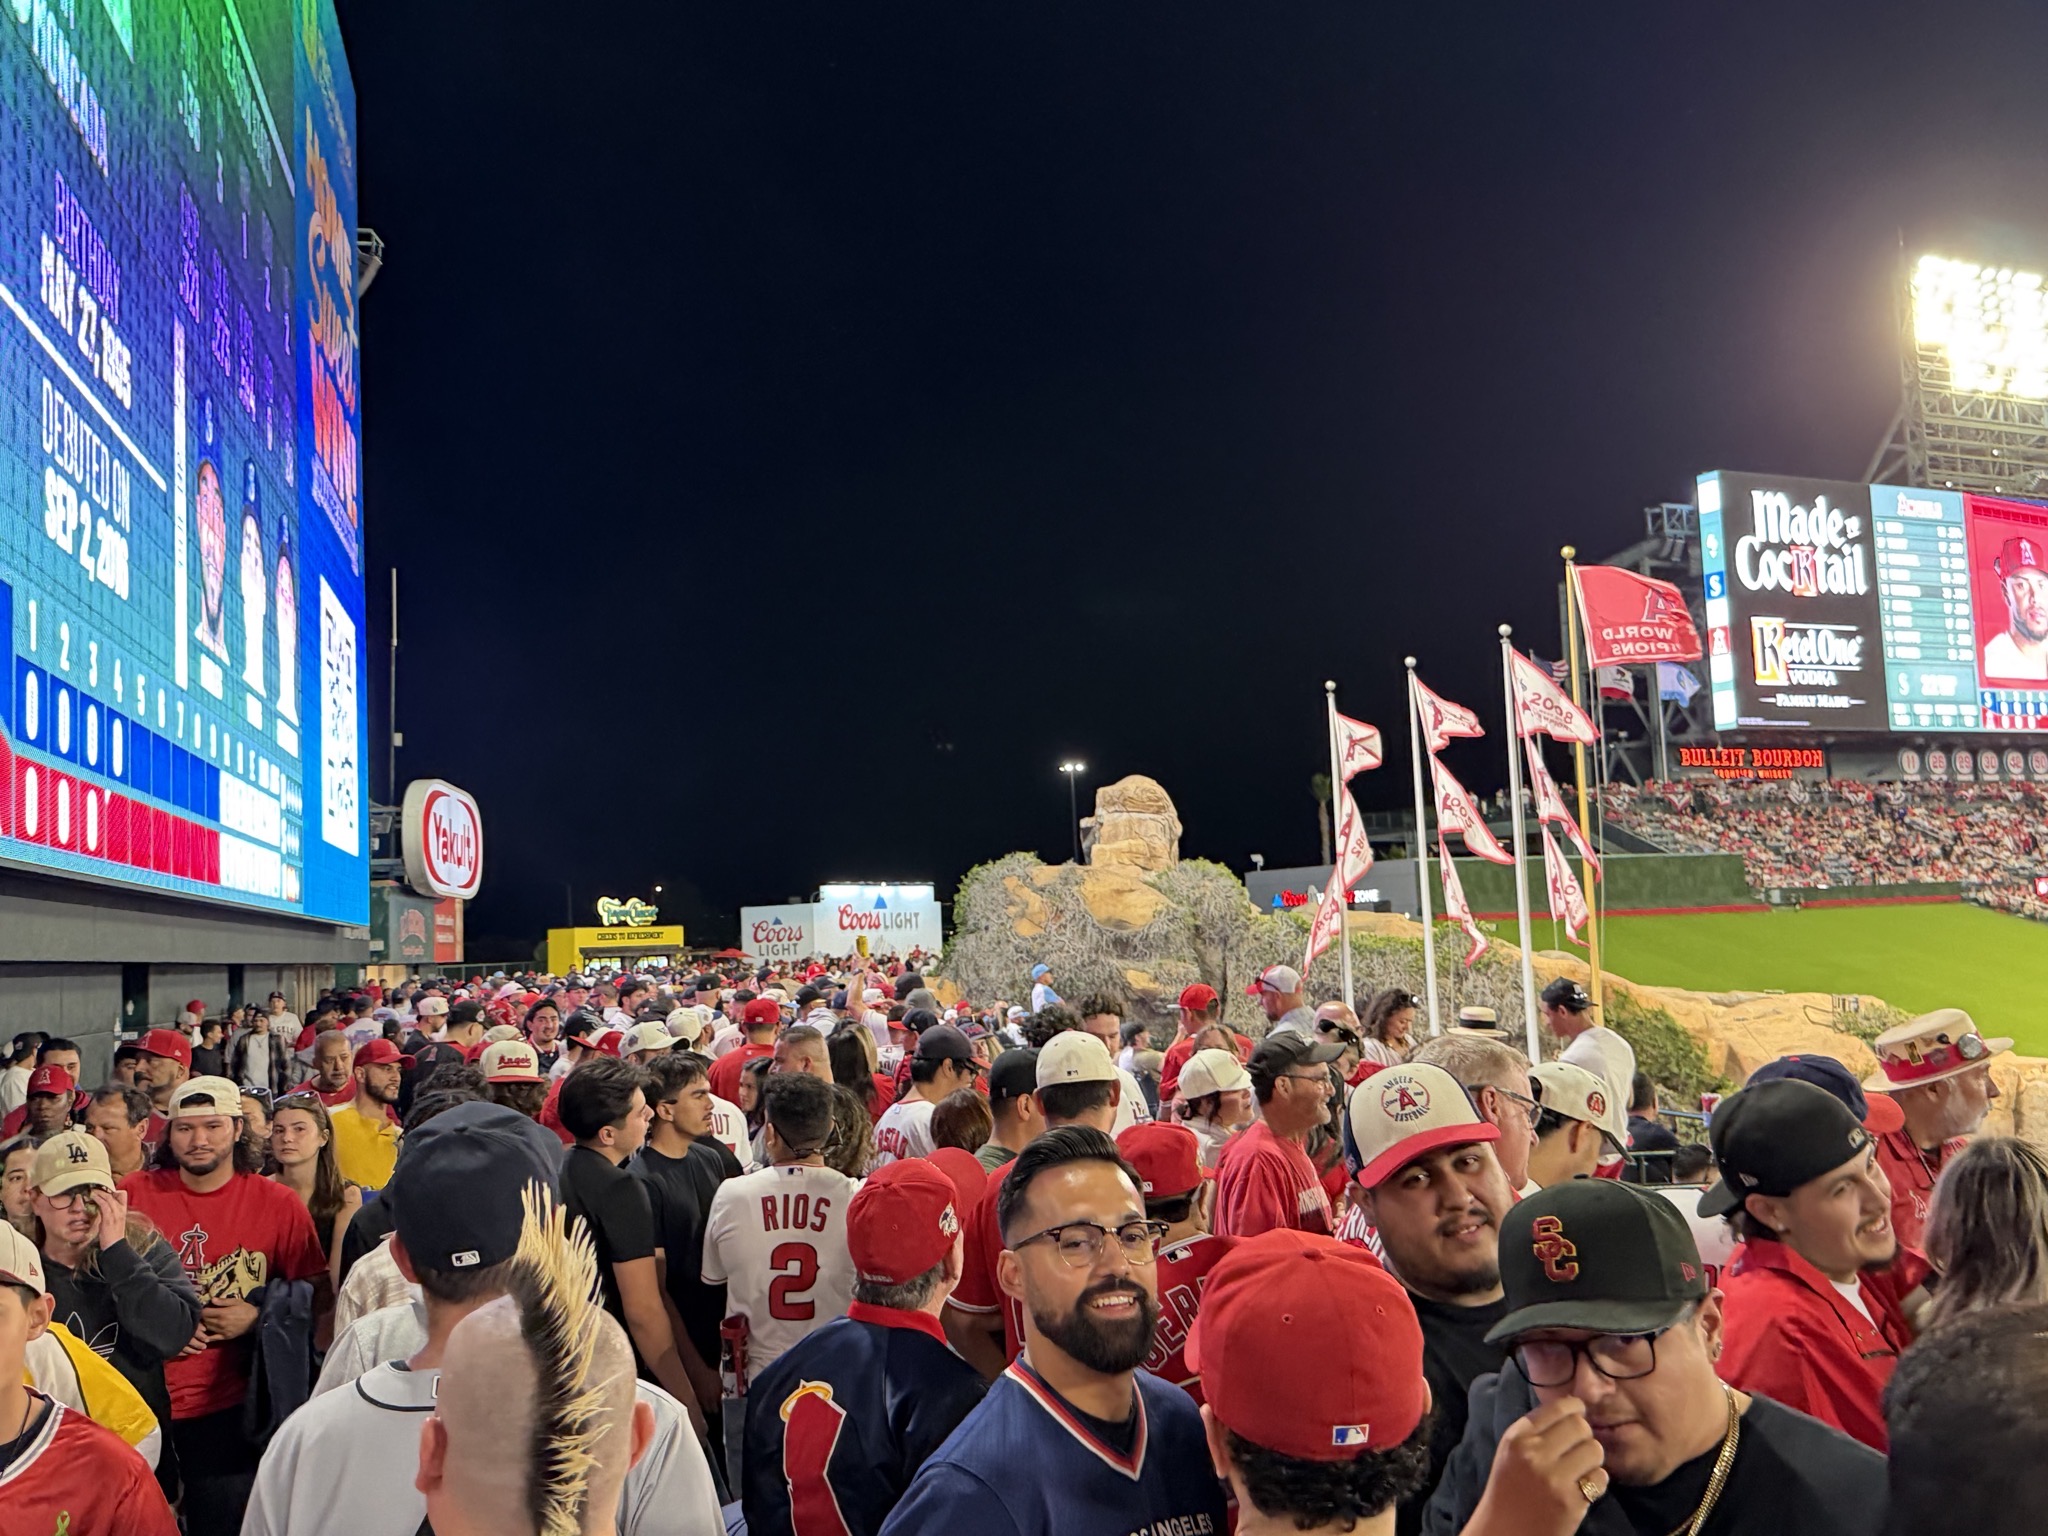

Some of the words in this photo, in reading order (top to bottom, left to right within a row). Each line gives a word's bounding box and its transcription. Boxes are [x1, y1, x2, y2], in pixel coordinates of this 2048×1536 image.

[306, 105, 353, 292] HOME
[55, 169, 120, 325] BIRTHDAY
[41, 230, 76, 336] MAY
[42, 376, 110, 511] DEBUTED
[112, 457, 130, 533] ON
[44, 465, 78, 555] SEP
[79, 500, 95, 582] 2,
[96, 516, 129, 600] 2016
[1751, 490, 1847, 549] Made
[28, 599, 37, 652] 1
[60, 621, 70, 672] 2
[88, 640, 98, 688] 3
[113, 657, 123, 703] 4
[137, 673, 146, 716] 5
[1753, 620, 1817, 684] Ketel
[1818, 629, 1862, 666] One
[1788, 669, 1839, 687] VODKA
[26, 671, 39, 740] 0
[58, 688, 71, 755] 0
[87, 704, 98, 767] 0
[1680, 748, 1745, 767] BULLEIT
[1752, 749, 1823, 767] BOURBON
[1984, 754, 1997, 769] 30
[26, 766, 38, 837] 0
[58, 778, 70, 845] 0
[86, 788, 98, 851] 0
[433, 811, 473, 872] Yakult
[752, 920, 803, 943] Coors
[838, 903, 881, 931] Coors
[883, 912, 920, 931] LIGHT
[758, 943, 799, 957] LIGHT
[1384, 1076, 1413, 1090] ANGELS
[66, 1143, 88, 1163] LA
[761, 1193, 831, 1232] RIOS
[769, 1242, 820, 1321] 2
